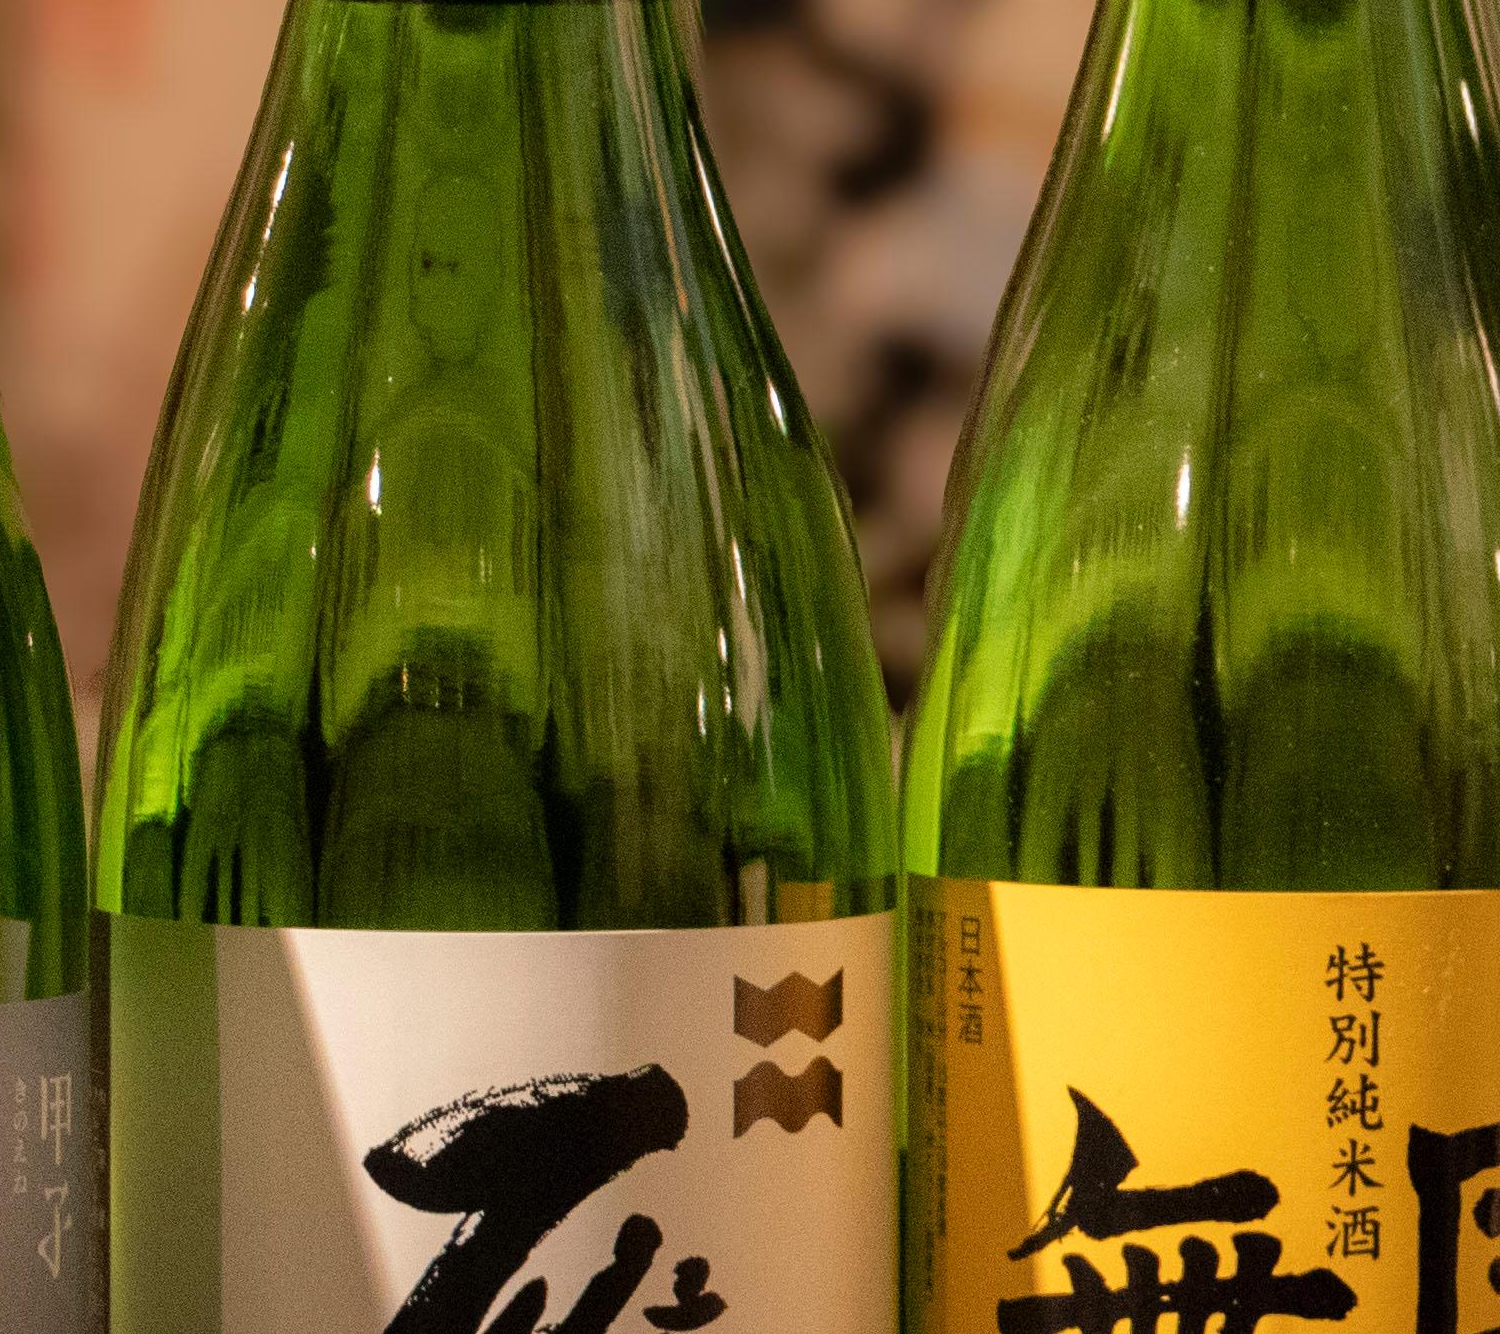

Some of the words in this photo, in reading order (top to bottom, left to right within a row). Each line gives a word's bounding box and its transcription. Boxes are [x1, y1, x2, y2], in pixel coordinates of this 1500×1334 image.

[958, 916, 983, 1045] 日本酒
[37, 1071, 73, 1280] 甲子
[1325, 942, 1386, 1262] 特別純米酒
